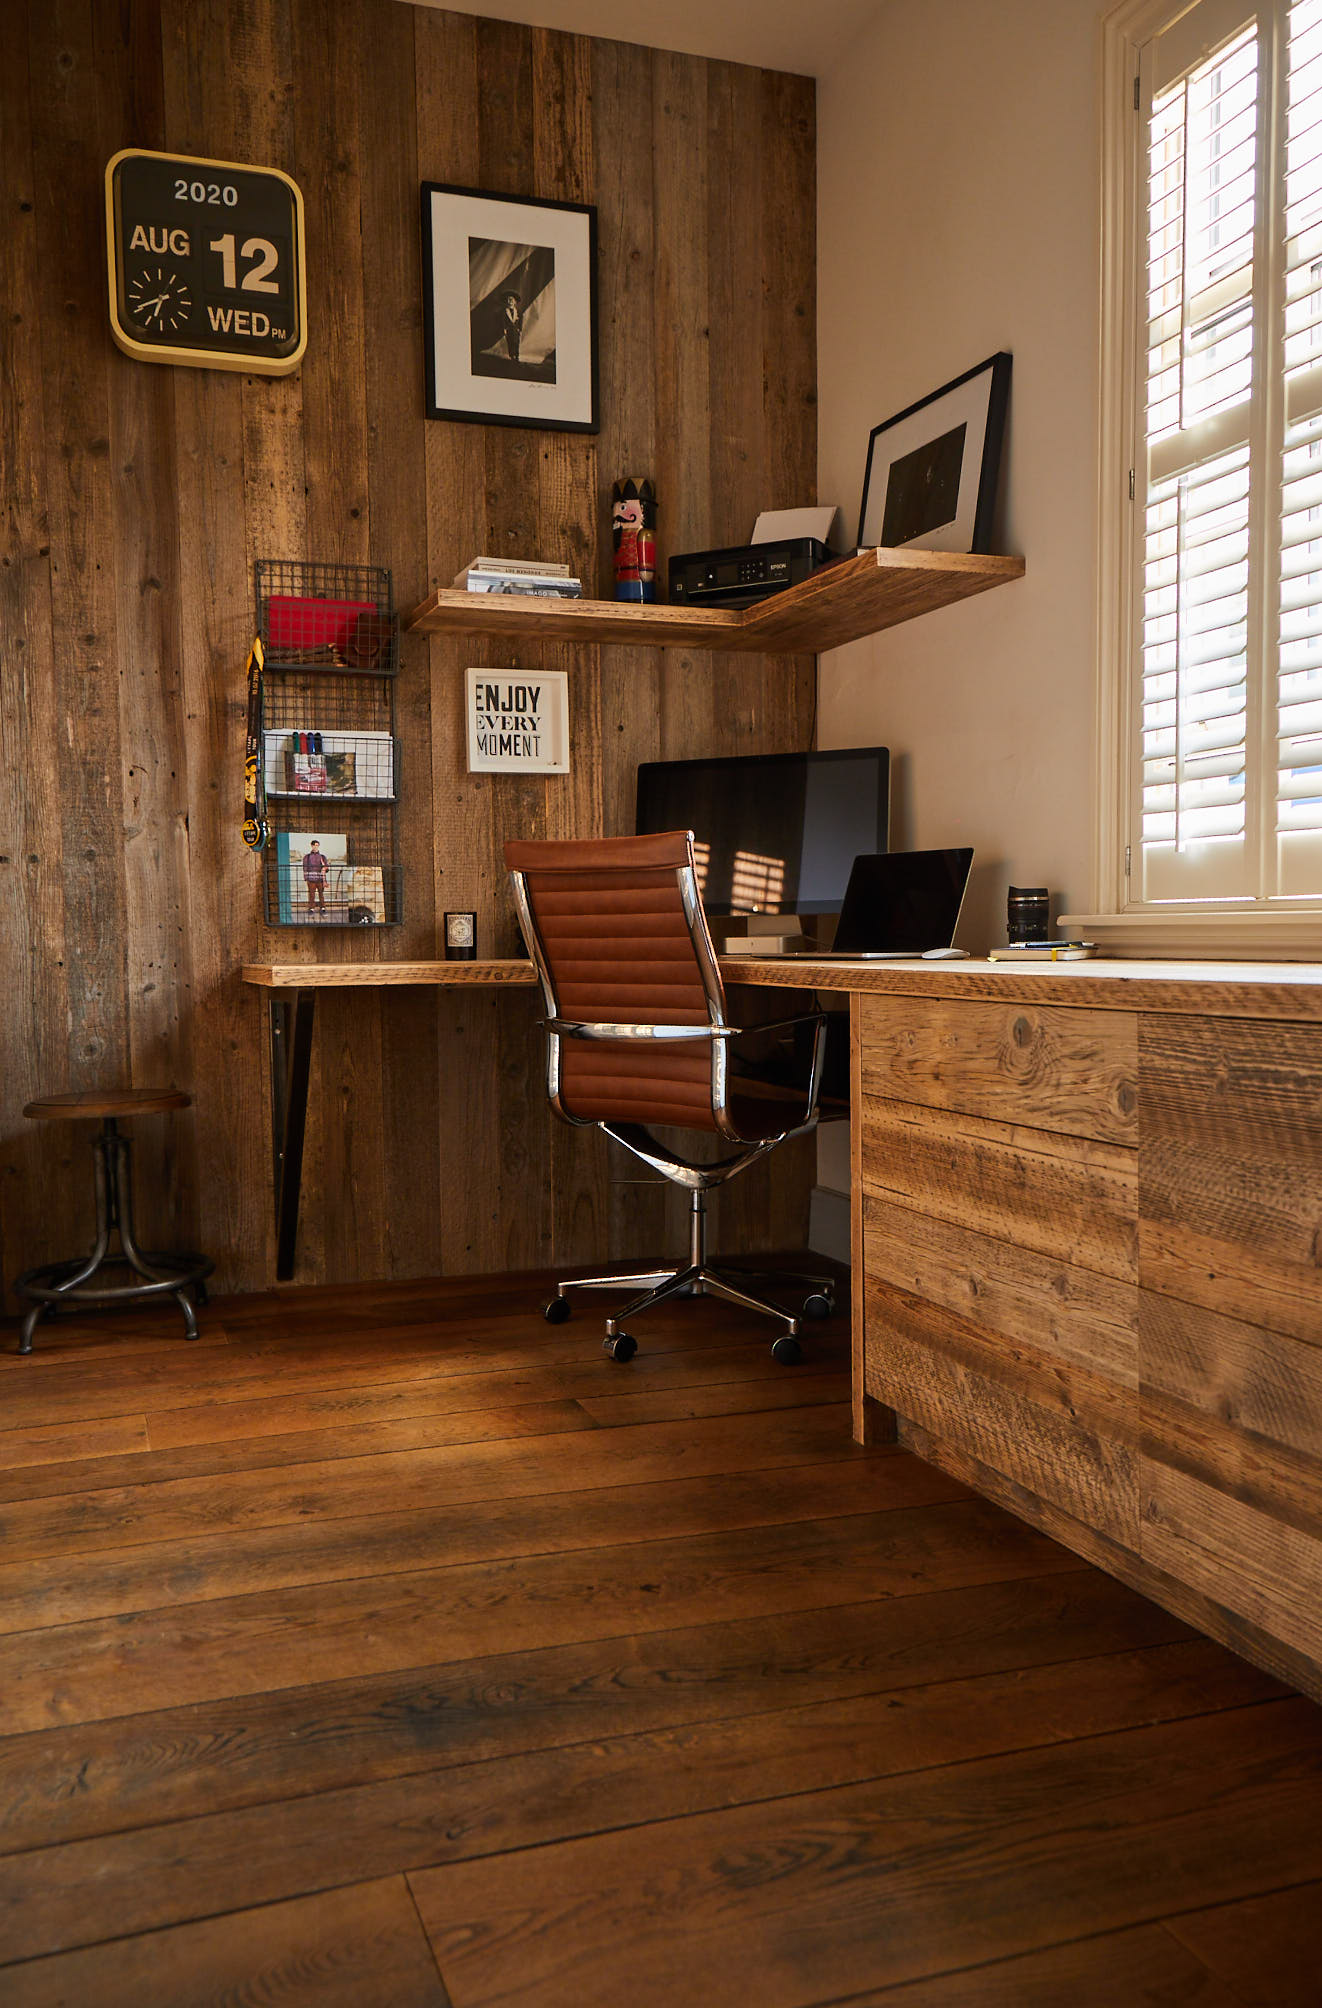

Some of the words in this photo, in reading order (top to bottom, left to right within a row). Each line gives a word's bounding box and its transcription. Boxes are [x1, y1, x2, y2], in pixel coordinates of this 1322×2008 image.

[174, 179, 238, 207] 2020
[129, 224, 191, 257] AUG
[209, 233, 280, 294] 12
[207, 305, 270, 337] WED
[271, 327, 287, 340] PM
[475, 683, 541, 713] ENJOY
[475, 714, 541, 732] EVERY
[476, 733, 541, 757] MOMENT
